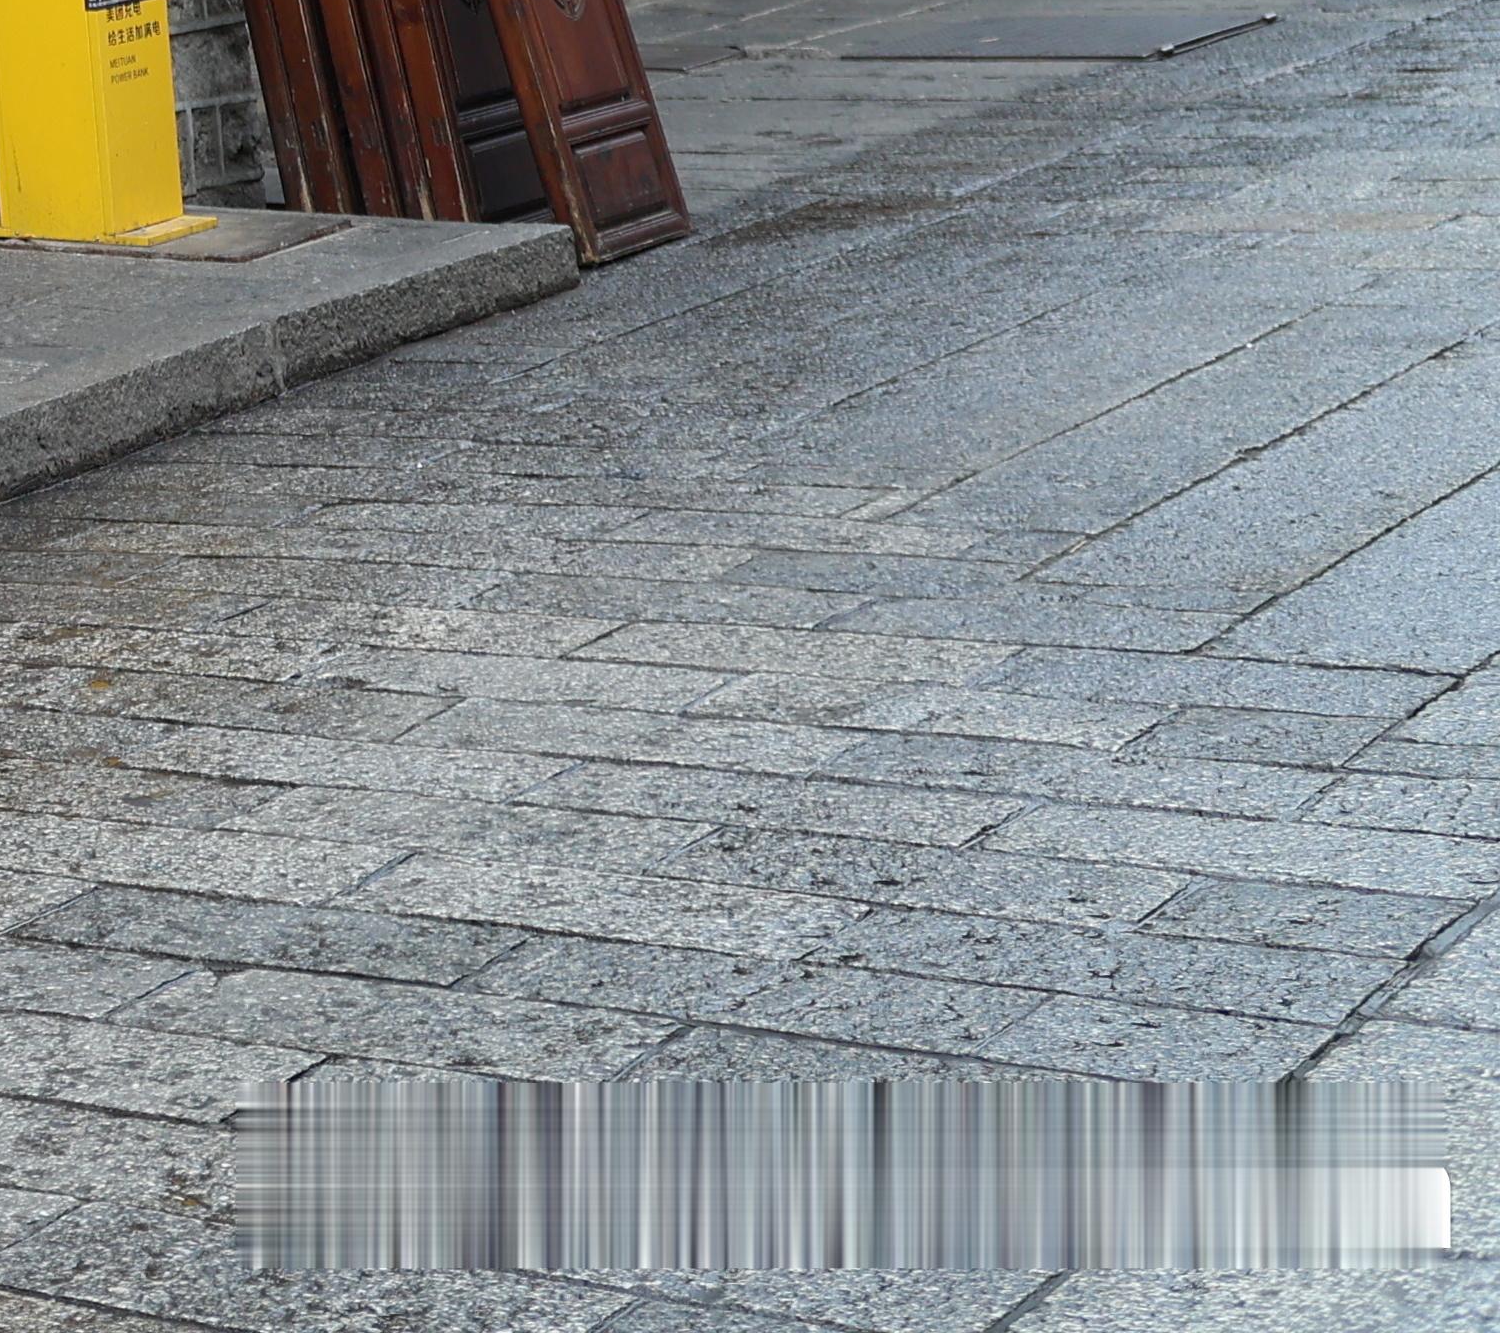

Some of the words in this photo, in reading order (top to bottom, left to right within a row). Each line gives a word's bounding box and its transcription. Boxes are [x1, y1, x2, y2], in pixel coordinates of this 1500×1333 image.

[107, 19, 162, 46] 给生活加满电
